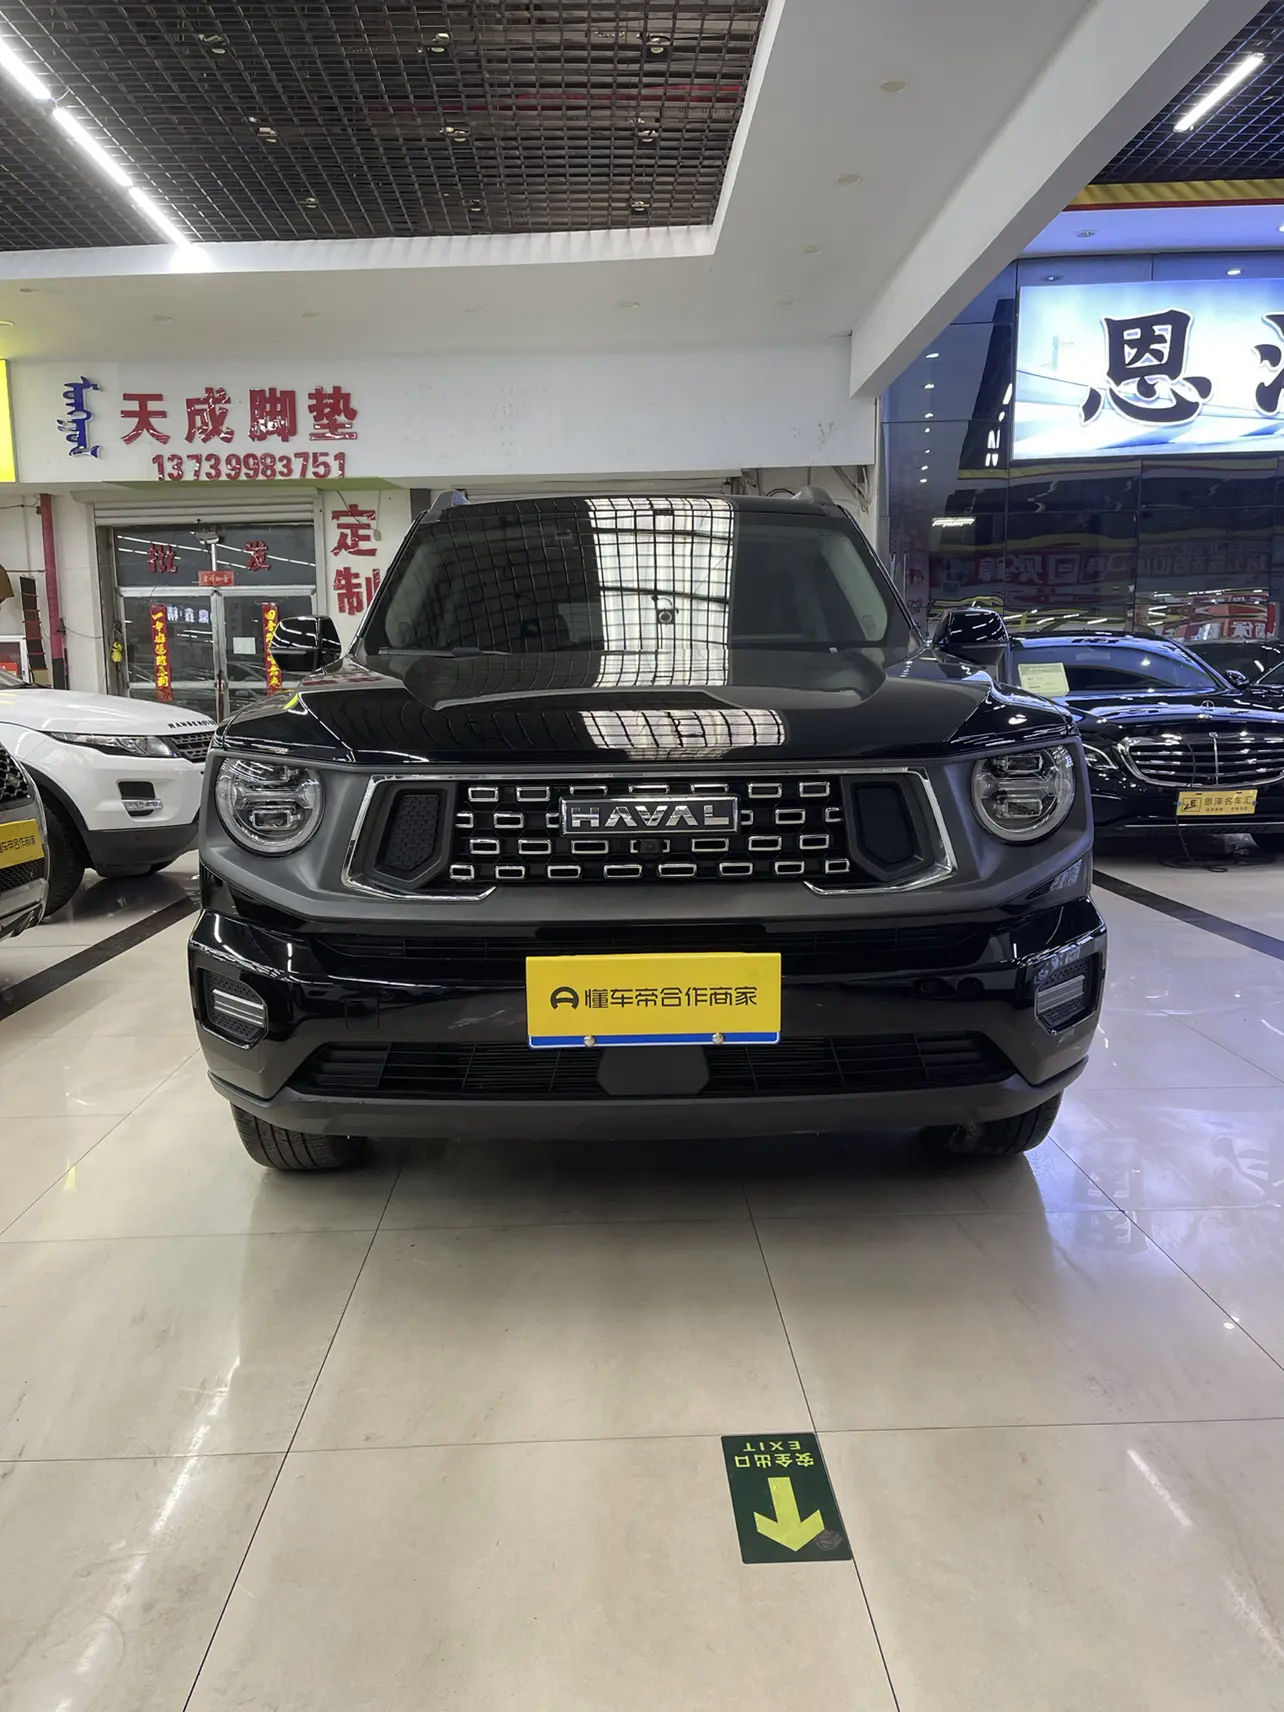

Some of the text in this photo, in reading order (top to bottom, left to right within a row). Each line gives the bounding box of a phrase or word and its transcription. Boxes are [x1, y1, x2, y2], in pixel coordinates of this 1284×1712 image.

[120, 385, 359, 445] 天成脚垫
[152, 451, 346, 482] 13739983751
[571, 804, 730, 828] HAVAL
[584, 985, 758, 1009] 懂车帝合作商家
[743, 1440, 801, 1452] EXIT
[734, 1452, 815, 1468] 安全出口
